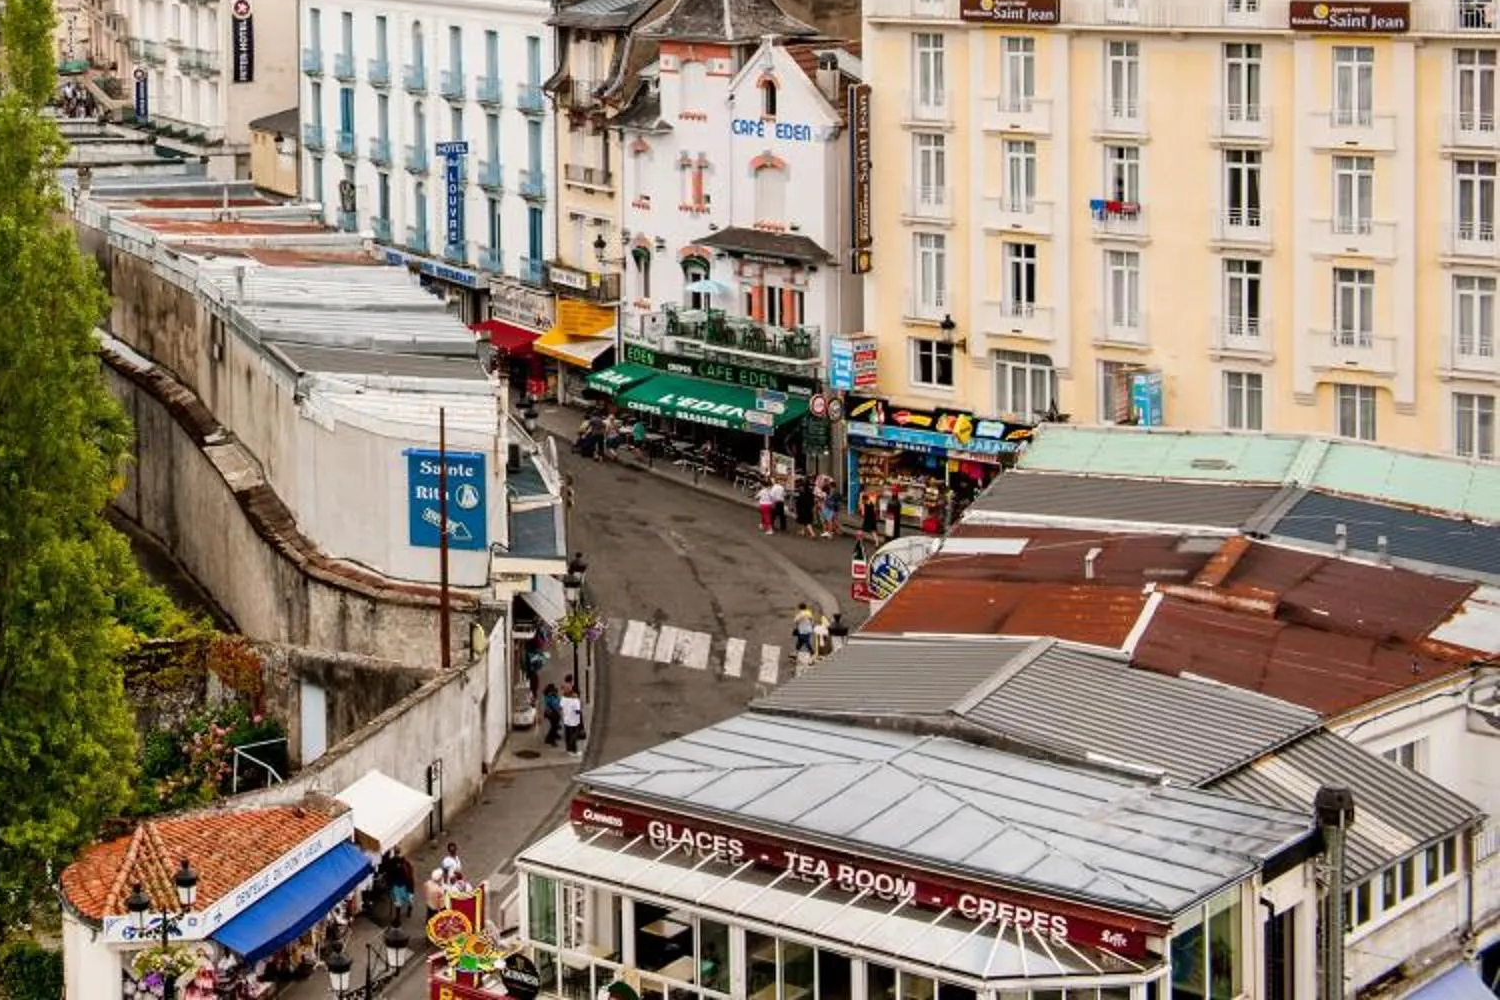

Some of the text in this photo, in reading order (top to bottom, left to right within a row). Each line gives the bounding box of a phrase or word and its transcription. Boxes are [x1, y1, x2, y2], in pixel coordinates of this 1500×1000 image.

[993, 7, 1024, 19] Saint
[1027, 7, 1055, 21] Jean
[1329, 14, 1367, 28] Saint
[1371, 14, 1405, 29] Jean
[775, 123, 811, 142] EDEN
[860, 95, 870, 183] Saint Jean
[448, 171, 458, 242] LOUVRE
[627, 348, 655, 366] EDEN
[739, 371, 779, 389] EDEN
[675, 410, 729, 428] BRASSERIE
[647, 820, 744, 857] GLACES
[784, 850, 831, 880] TEA
[836, 864, 917, 899] ROOM
[957, 893, 1069, 938] CREPES
